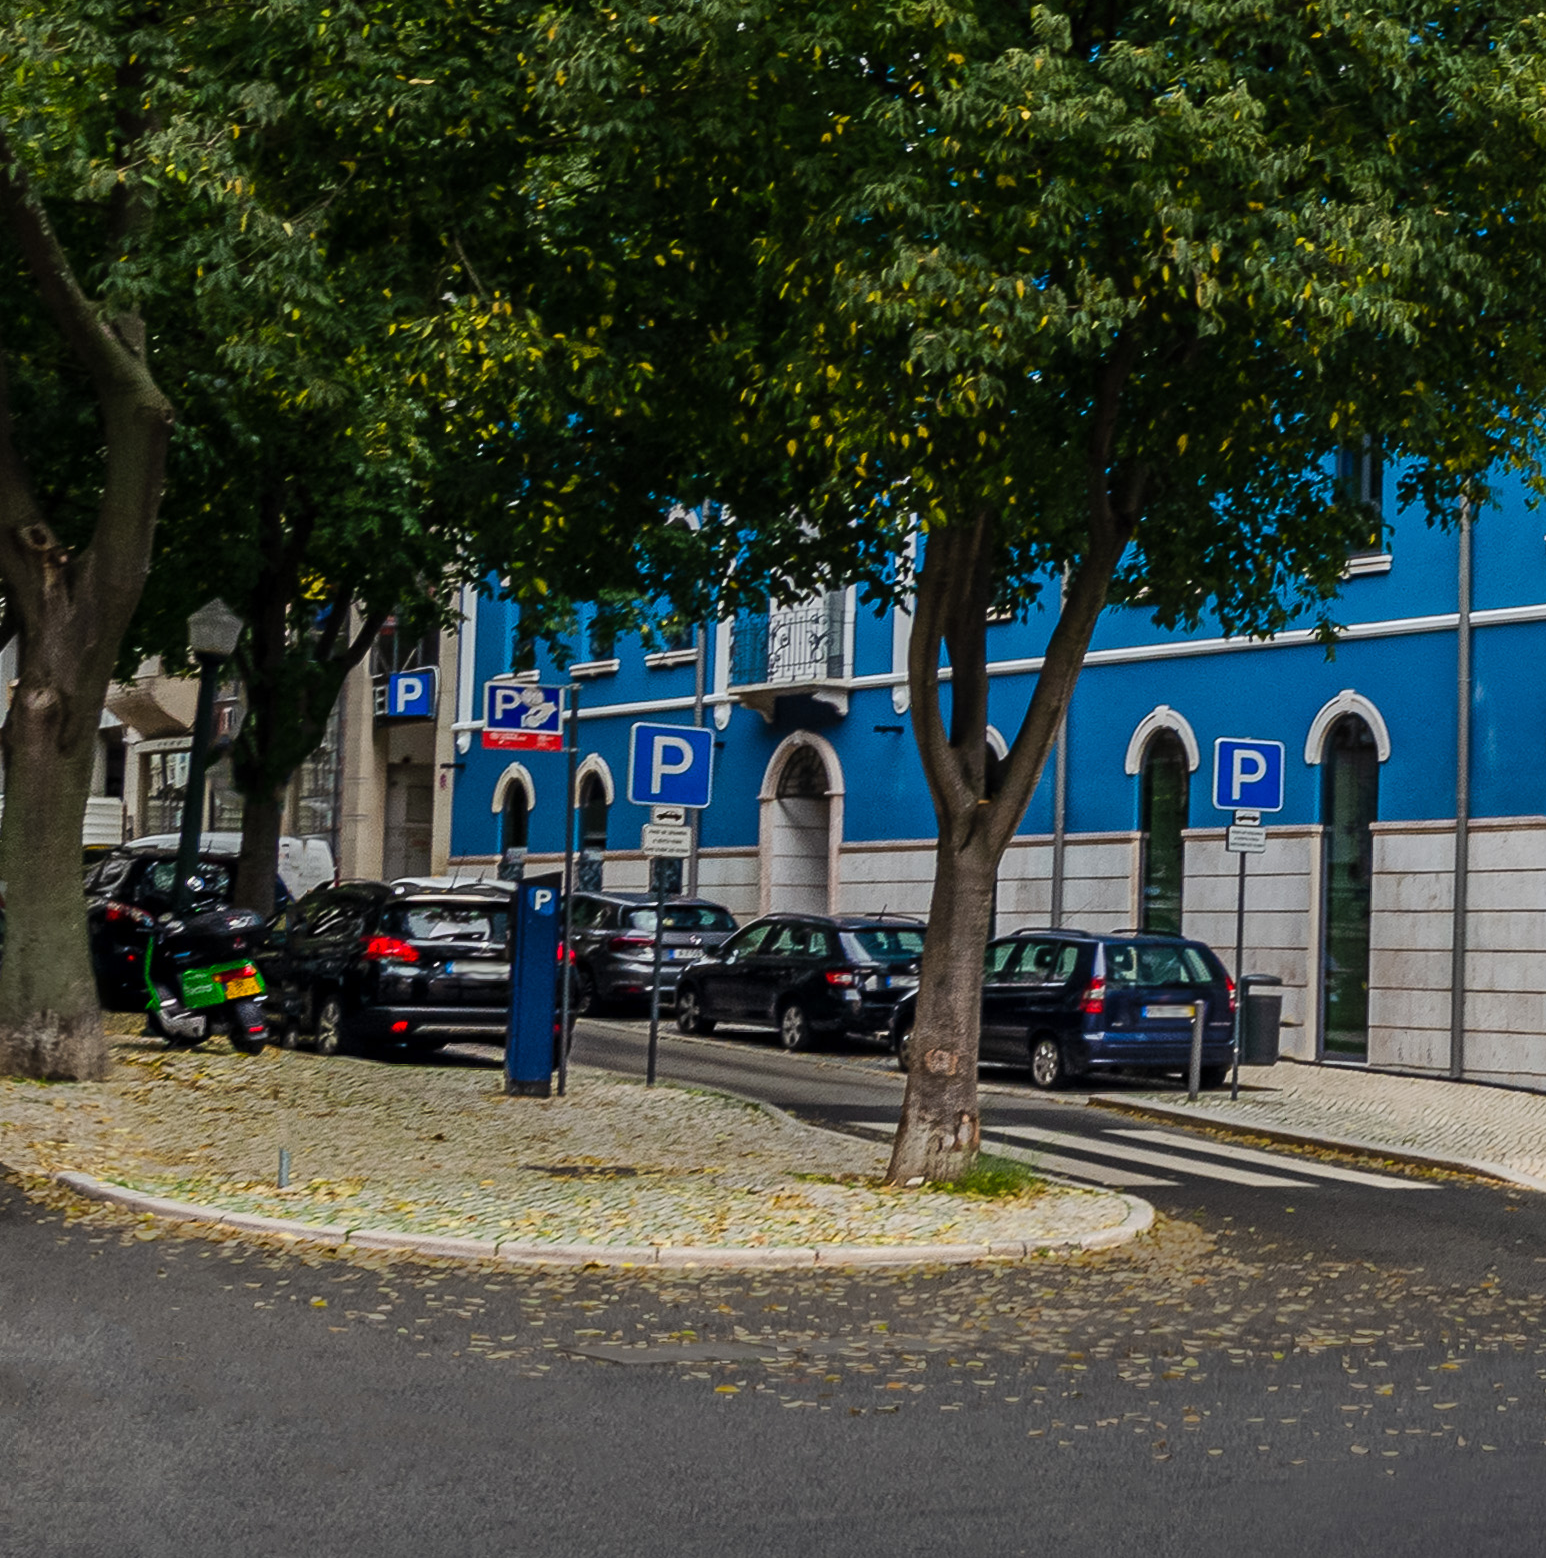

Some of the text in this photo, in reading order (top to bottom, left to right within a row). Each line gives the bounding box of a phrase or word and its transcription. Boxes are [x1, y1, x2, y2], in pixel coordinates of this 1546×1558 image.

[396, 677, 423, 713] P
[494, 688, 522, 720] P
[651, 735, 694, 795] P
[1231, 748, 1267, 801] P
[534, 888, 553, 912] P
